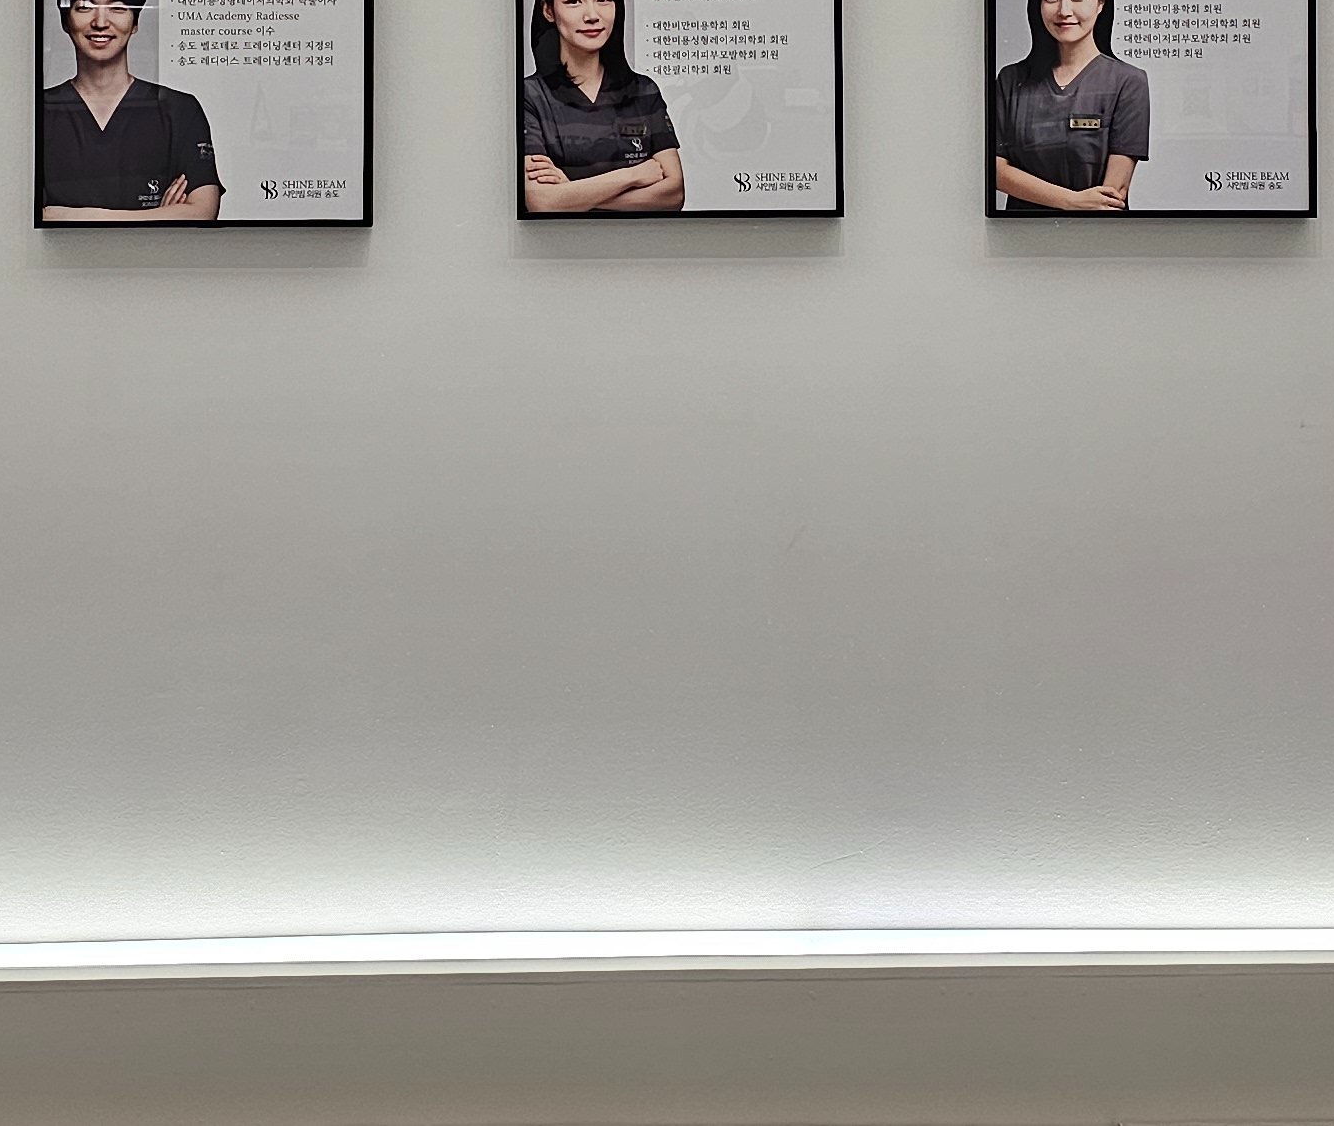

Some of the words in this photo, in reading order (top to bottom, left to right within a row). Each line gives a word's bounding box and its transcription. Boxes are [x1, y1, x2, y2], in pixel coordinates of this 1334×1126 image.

[178, 12, 203, 20] UMA
[206, 11, 252, 22] Academy
[257, 11, 300, 20] Radiesse
[181, 28, 215, 36] master
[756, 173, 785, 181] SHINE
[789, 173, 818, 181] BEAM
[1226, 172, 1257, 181] SHINE
[1261, 172, 1289, 180] BEAM
[283, 180, 314, 189] SHINE
[317, 180, 346, 189] BEAM
